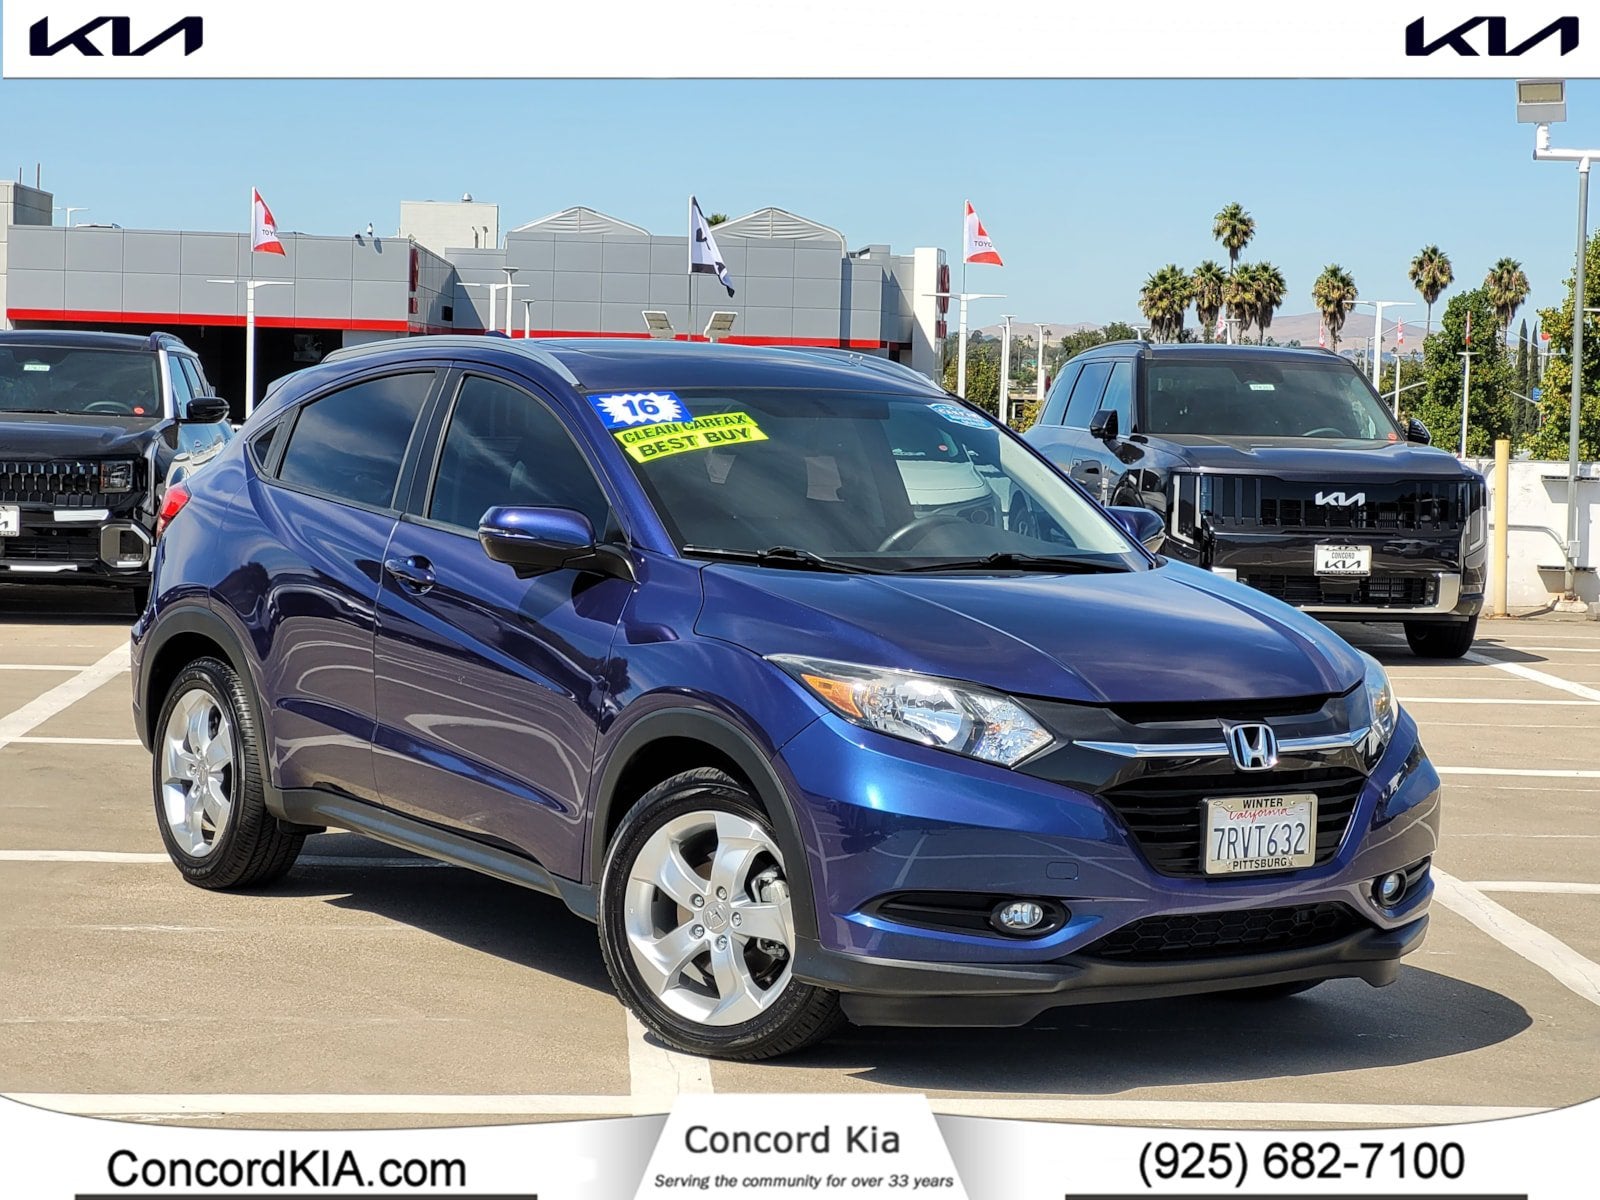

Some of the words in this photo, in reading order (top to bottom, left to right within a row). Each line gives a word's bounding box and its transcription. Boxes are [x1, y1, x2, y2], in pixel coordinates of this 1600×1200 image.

[622, 398, 660, 417] 16
[622, 424, 677, 444] CLEAN
[681, 414, 747, 431] CARFAX
[638, 435, 696, 458] BEST
[704, 427, 750, 444] BUY
[1315, 491, 1366, 507] KIA
[1325, 560, 1361, 569] KIA
[1242, 798, 1284, 809] WINTER
[1229, 807, 1294, 823] California
[1213, 822, 1306, 861] 7RVT632
[1232, 857, 1288, 871] PITTSBURG
